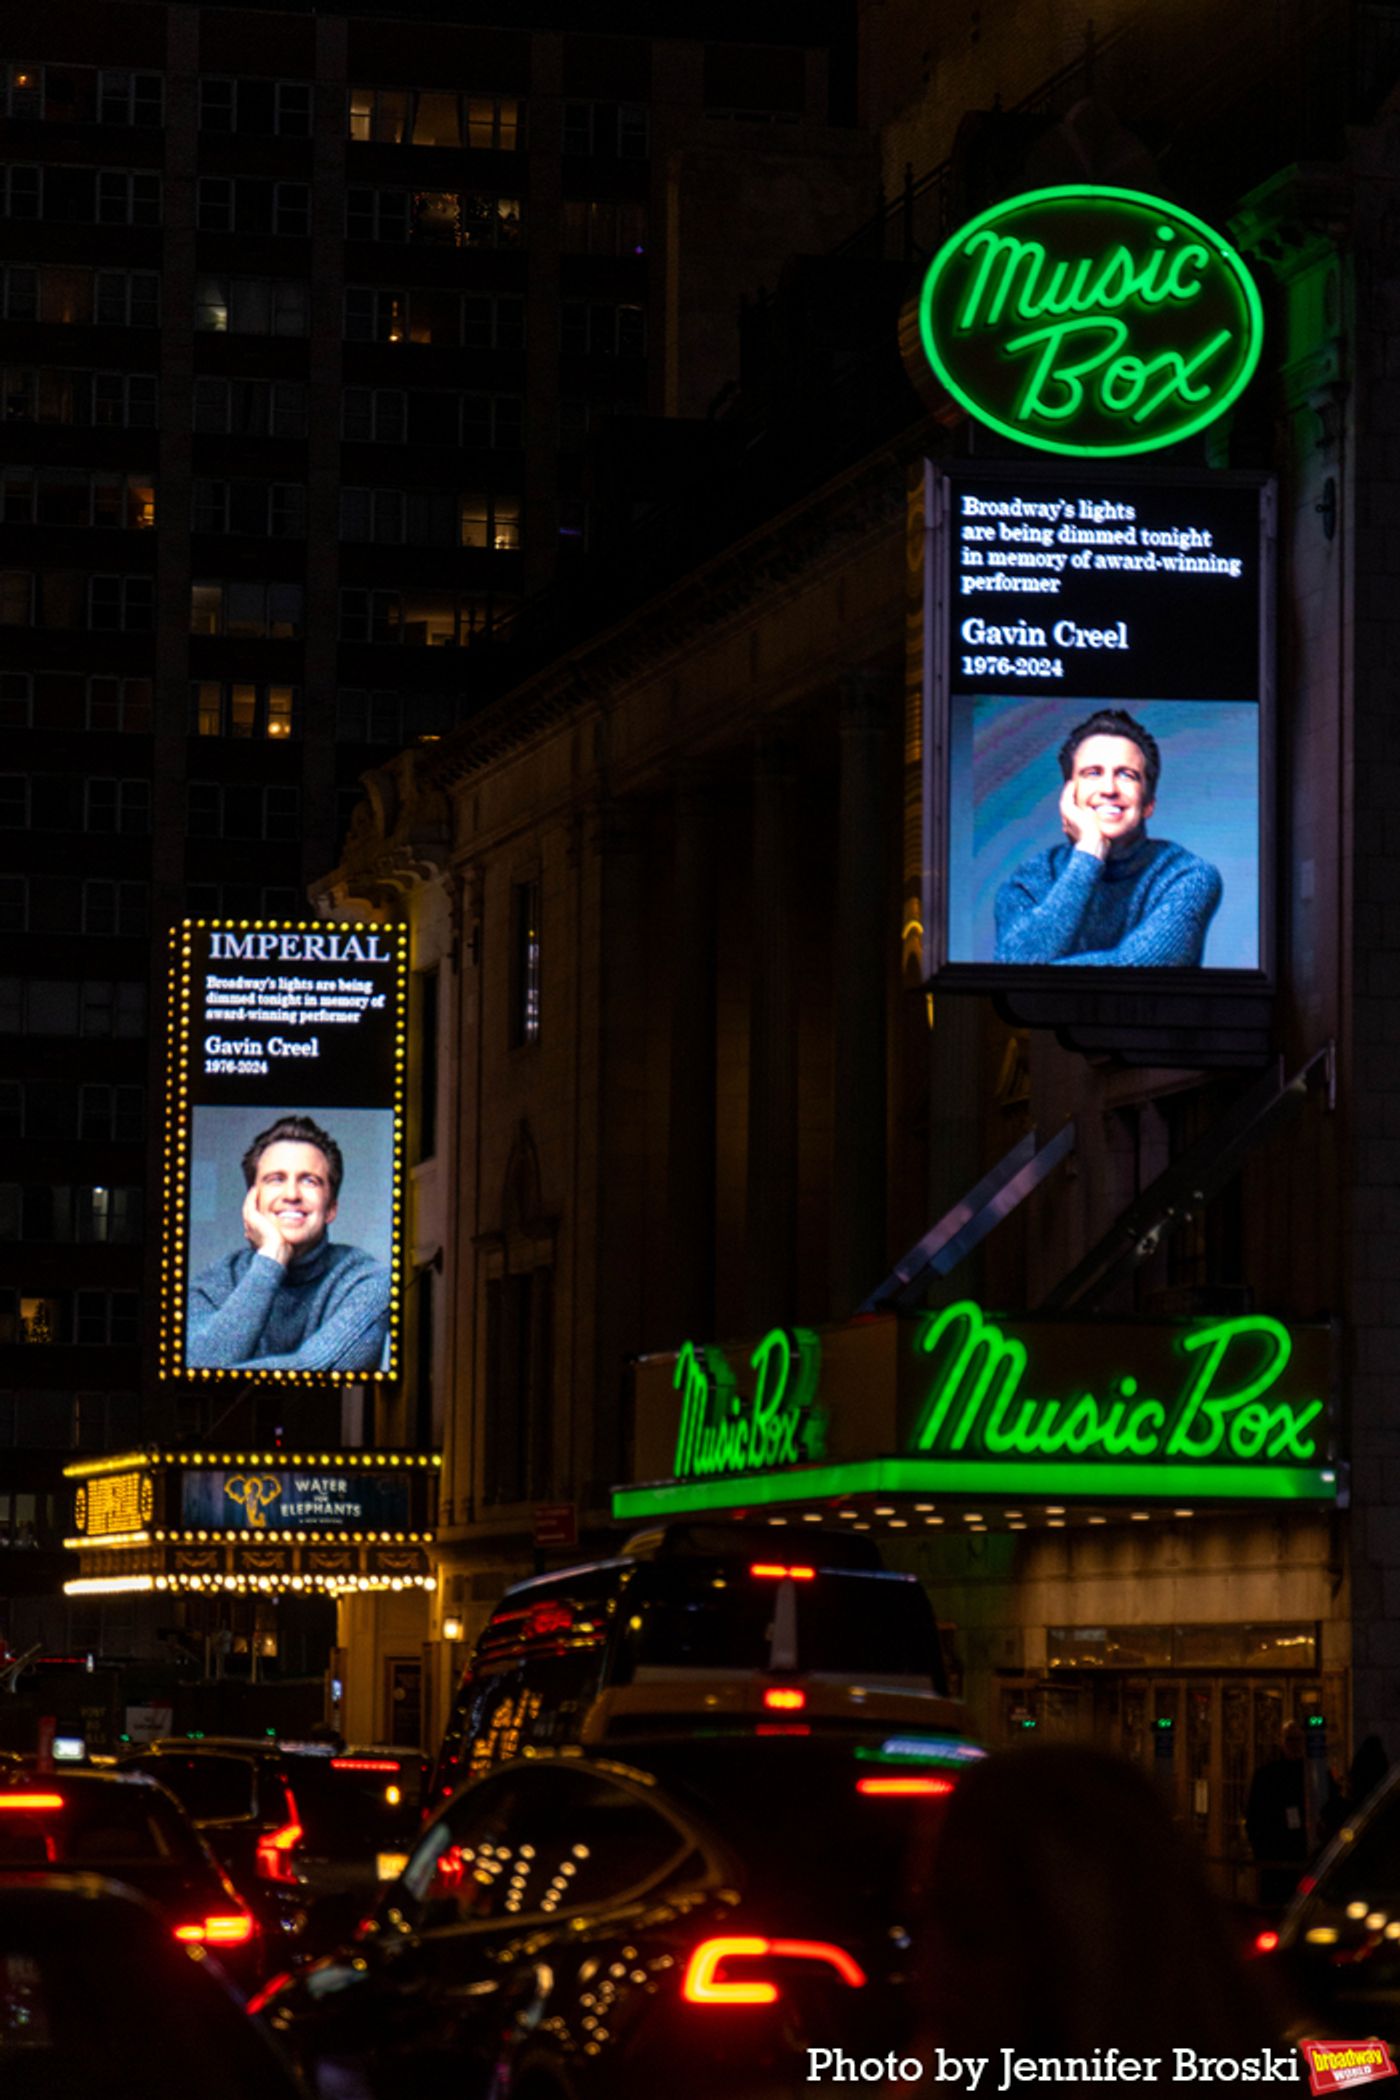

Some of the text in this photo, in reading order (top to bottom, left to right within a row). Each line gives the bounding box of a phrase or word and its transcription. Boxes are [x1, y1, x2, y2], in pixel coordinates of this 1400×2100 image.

[959, 226, 1209, 330] Music
[1004, 315, 1232, 422] Box
[961, 496, 1136, 523] Broadway's lights
[961, 522, 1213, 551] are being dimmed tonight
[961, 547, 1242, 577] in memory of award-winning
[961, 573, 1062, 594] performer
[961, 618, 1129, 649] Gavin Creel
[962, 656, 1064, 678] 1976-2024
[209, 933, 391, 962] IMPERIAL
[206, 975, 373, 994] Broadway's lights are being
[206, 992, 386, 1010] dimmed tonight in memory of
[206, 1008, 361, 1025] award-winning performer
[205, 1035, 319, 1057] Gavin Creel
[205, 1059, 268, 1074] 1976-2024
[922, 1300, 1323, 1459] Music Box
[673, 1327, 801, 1477] Music Box
[295, 1479, 347, 1493] WATER
[281, 1502, 361, 1517] ELEPHANTS
